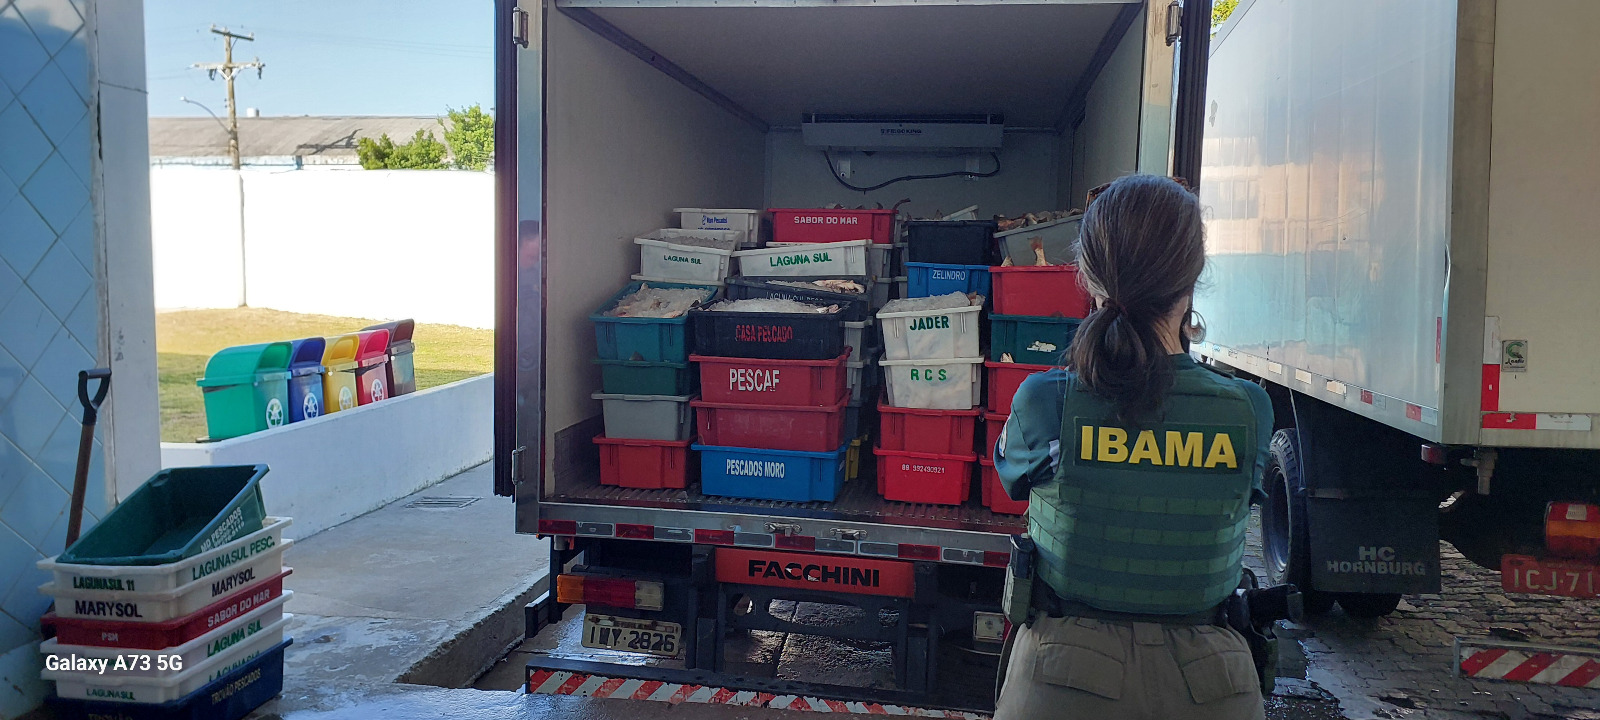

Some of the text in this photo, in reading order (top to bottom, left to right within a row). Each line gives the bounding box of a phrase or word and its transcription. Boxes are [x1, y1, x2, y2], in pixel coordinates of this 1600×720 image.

[794, 216, 823, 224] SABOR
[840, 217, 858, 225] MAR
[664, 255, 702, 265] LAGUNA SUL
[770, 252, 832, 267] LAGUNA SUL
[932, 269, 966, 281] ZELINDRO
[909, 315, 950, 331] JADER
[736, 324, 756, 341] CASA
[1080, 425, 1238, 469] IBAMA
[726, 458, 785, 479] PESCADOS MORO
[1358, 546, 1396, 561] HC
[748, 559, 880, 588] FACCHINI
[1326, 560, 1426, 576] HORNBURG
[211, 567, 256, 597] MARYSOL
[75, 600, 143, 618] MARYSOL
[207, 589, 270, 628] SABOR DO MAR
[207, 620, 263, 658] LAGUNA SUL
